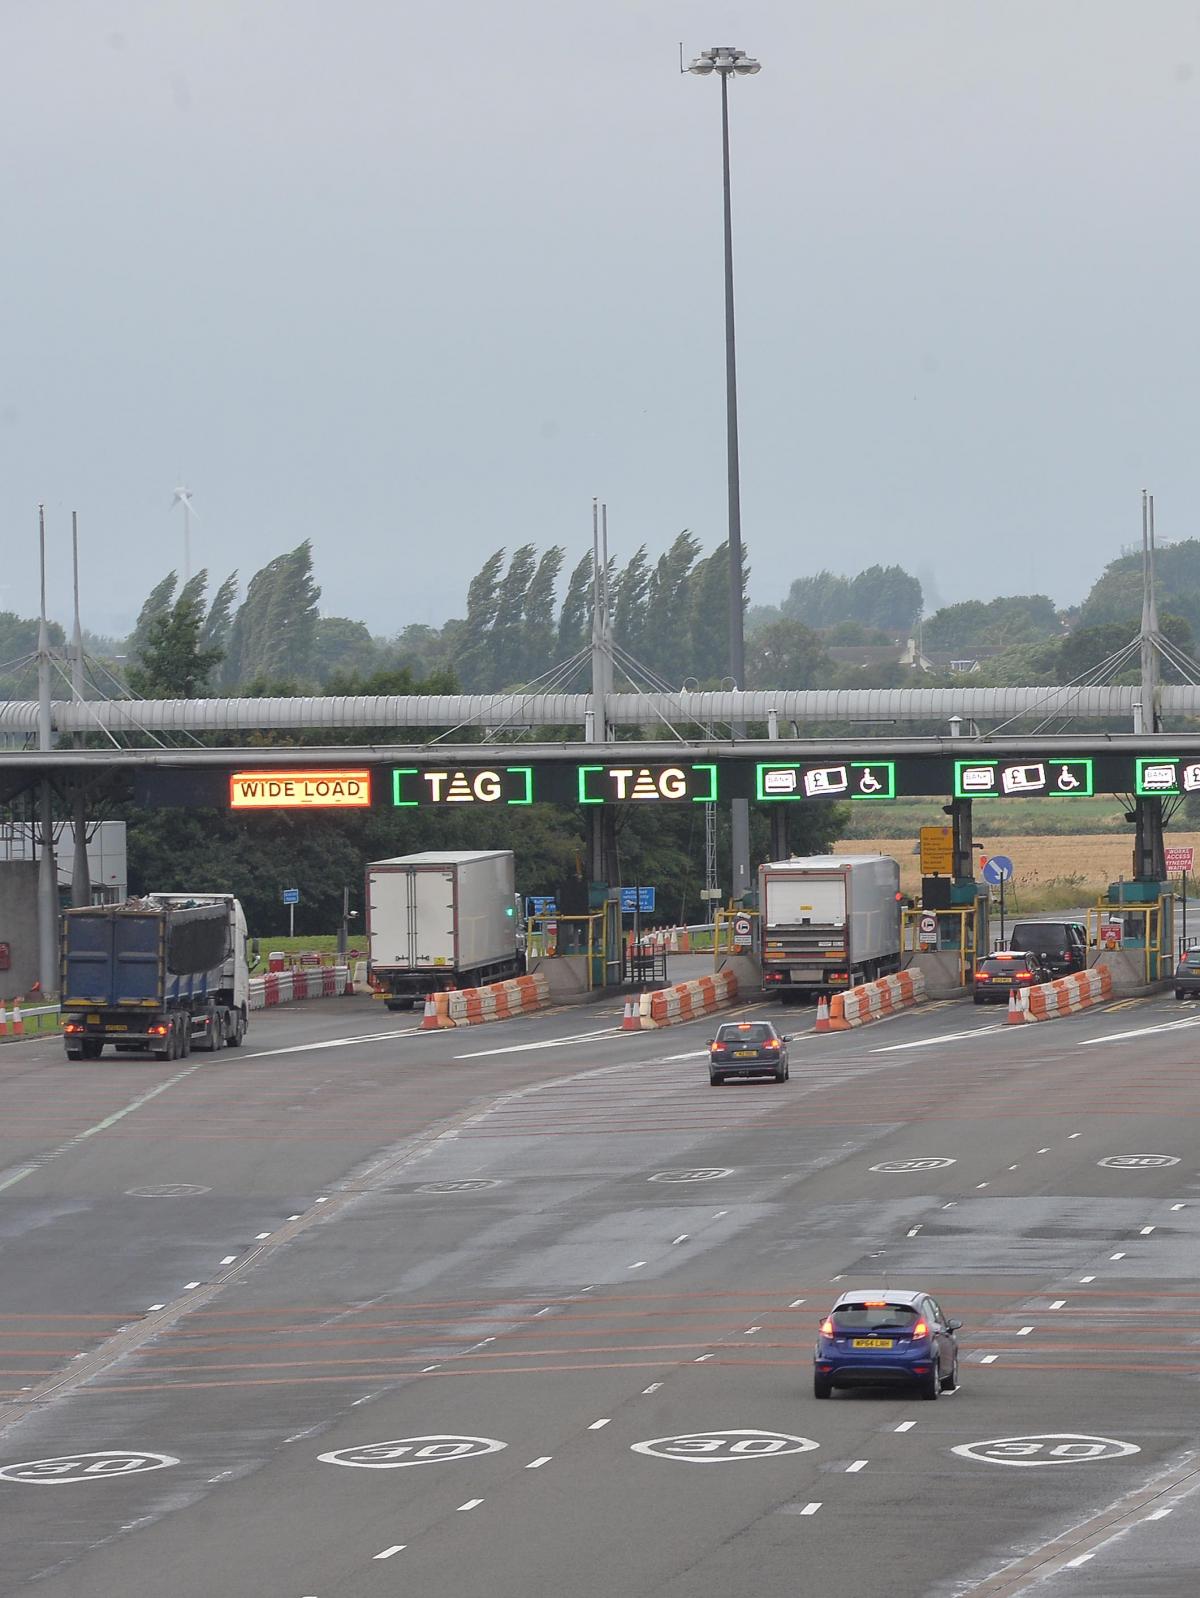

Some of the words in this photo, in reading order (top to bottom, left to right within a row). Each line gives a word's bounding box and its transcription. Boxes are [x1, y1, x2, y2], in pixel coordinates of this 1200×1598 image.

[241, 782, 296, 798] WIDE
[304, 781, 361, 797] LOAD
[424, 771, 501, 802] TAG
[609, 768, 686, 799] TAG
[884, 1161, 940, 1169] 30
[350, 1443, 475, 1461] 30
[664, 1439, 788, 1453] 30
[985, 1443, 1107, 1457] 30
[17, 1458, 146, 1476] 30
